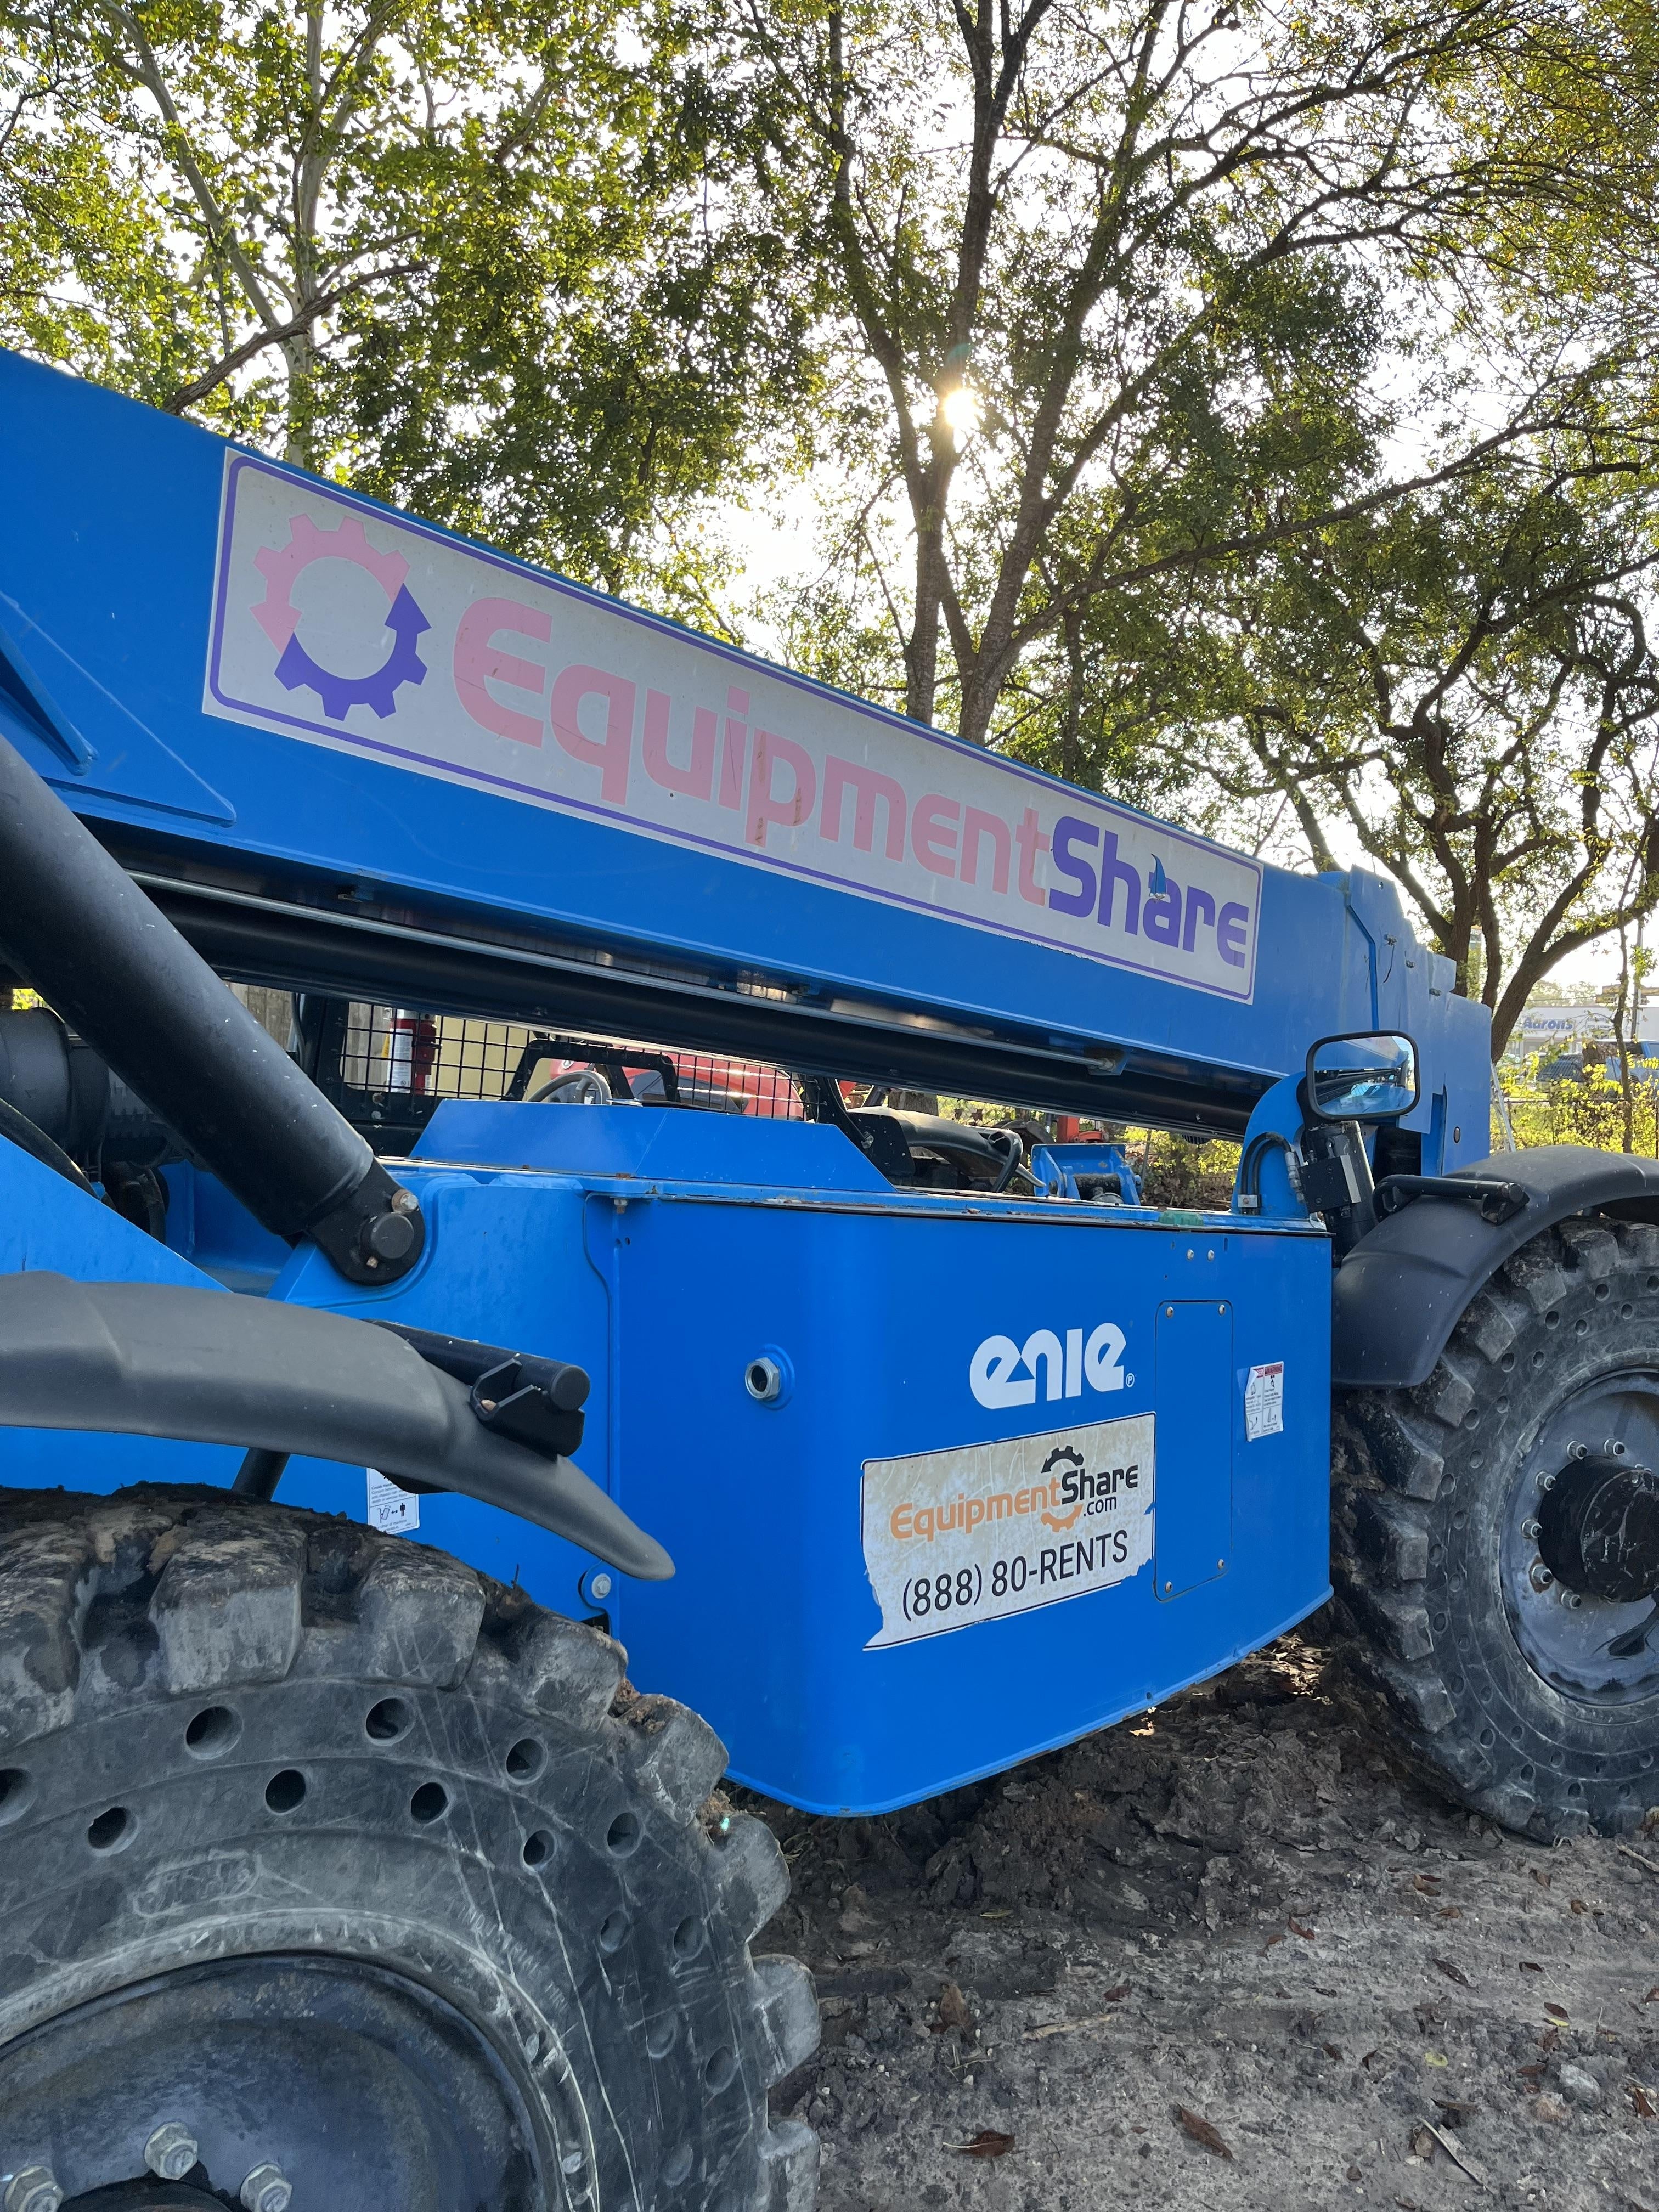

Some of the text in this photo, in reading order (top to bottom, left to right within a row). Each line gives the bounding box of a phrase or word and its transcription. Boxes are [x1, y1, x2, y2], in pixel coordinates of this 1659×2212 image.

[452, 597, 1249, 969] EquipmentShare
[890, 1464, 1138, 1542] EquipmentShare
[902, 1530, 1127, 1622] (888) 80-RENTS
